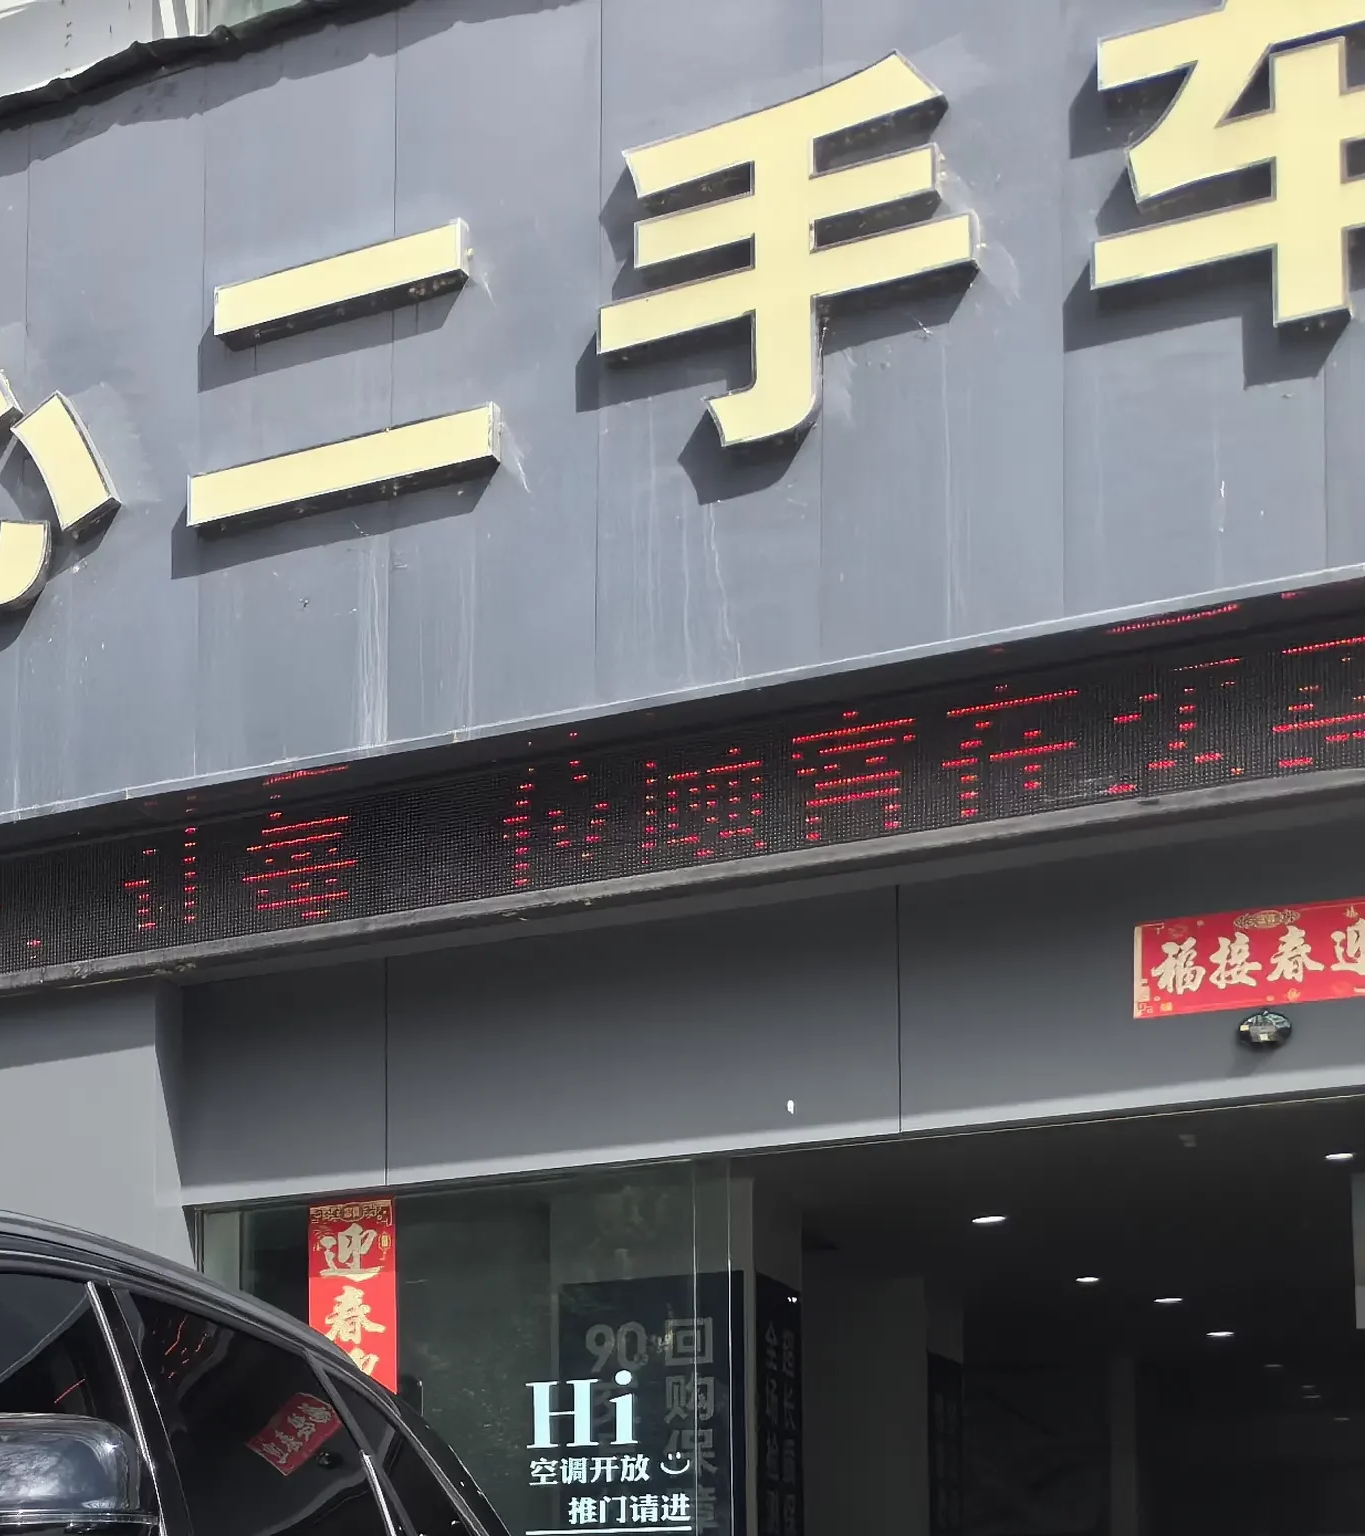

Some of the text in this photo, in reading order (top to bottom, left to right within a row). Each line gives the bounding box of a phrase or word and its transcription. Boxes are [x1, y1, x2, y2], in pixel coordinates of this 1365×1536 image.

[525, 1369, 639, 1450] Hi
[528, 1453, 651, 1486] 空调开放
[568, 1493, 692, 1526] 推门请进
